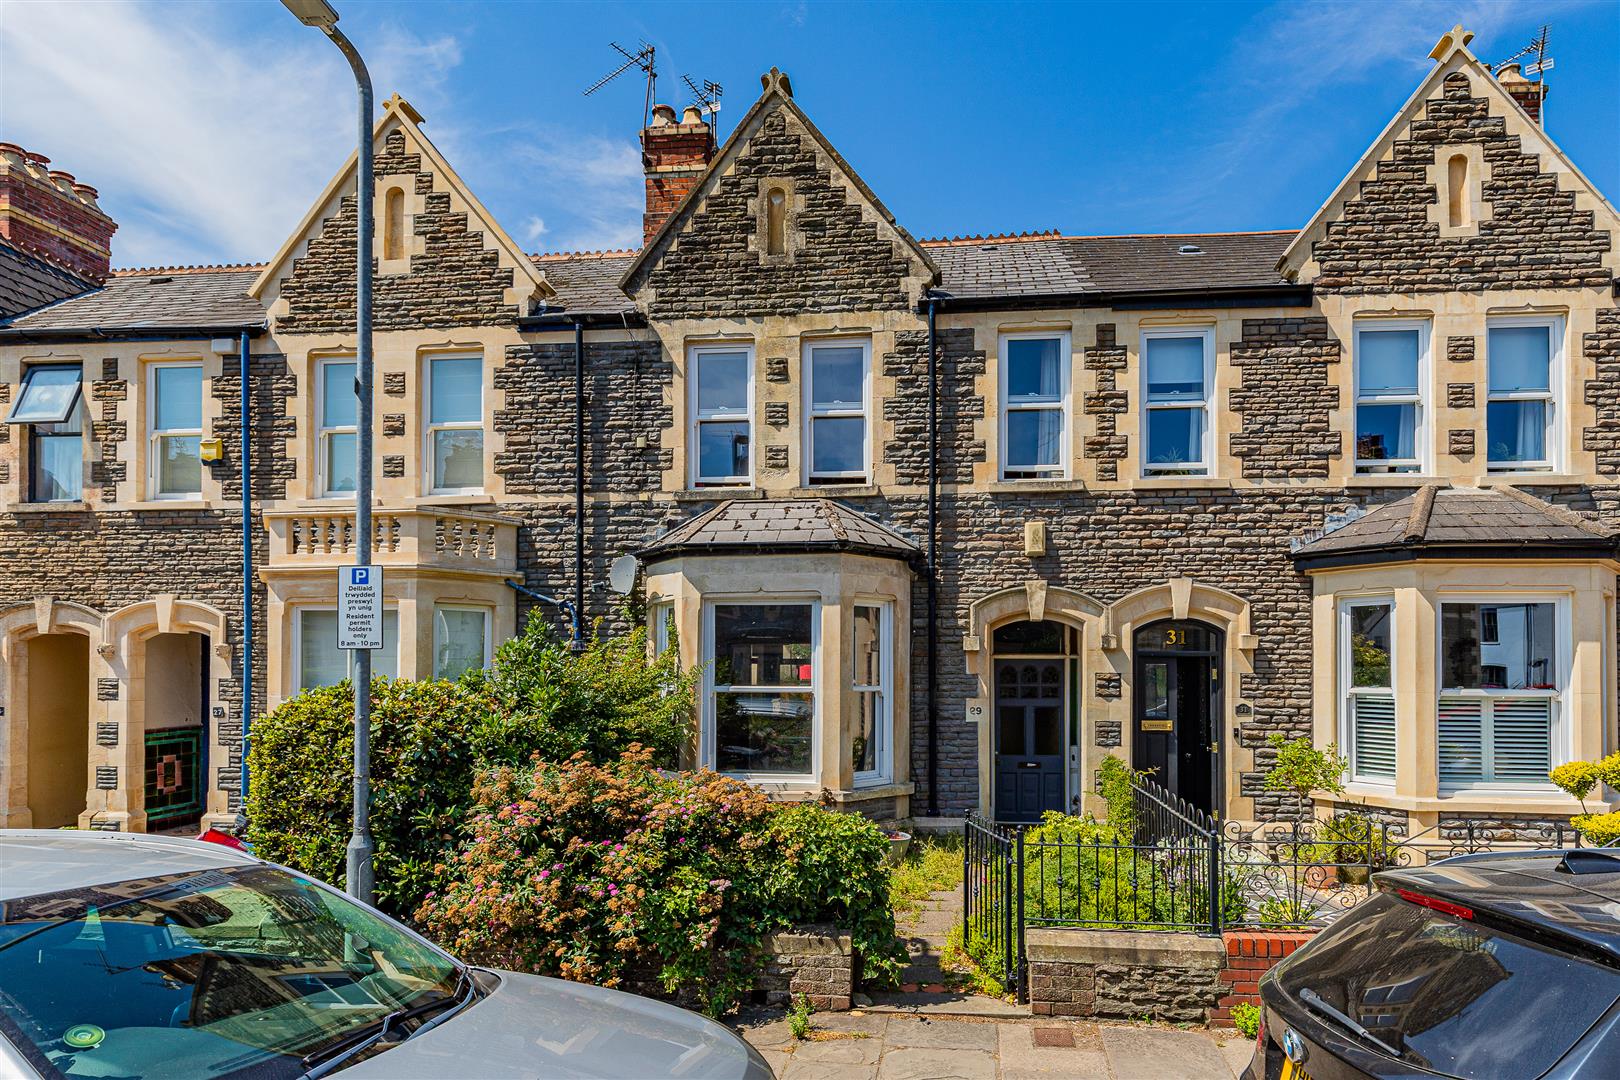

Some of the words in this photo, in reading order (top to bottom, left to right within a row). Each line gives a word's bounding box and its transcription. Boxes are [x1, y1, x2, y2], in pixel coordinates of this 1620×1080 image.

[356, 570, 366, 583] P
[1166, 629, 1186, 645] 31
[970, 706, 982, 715] 29
